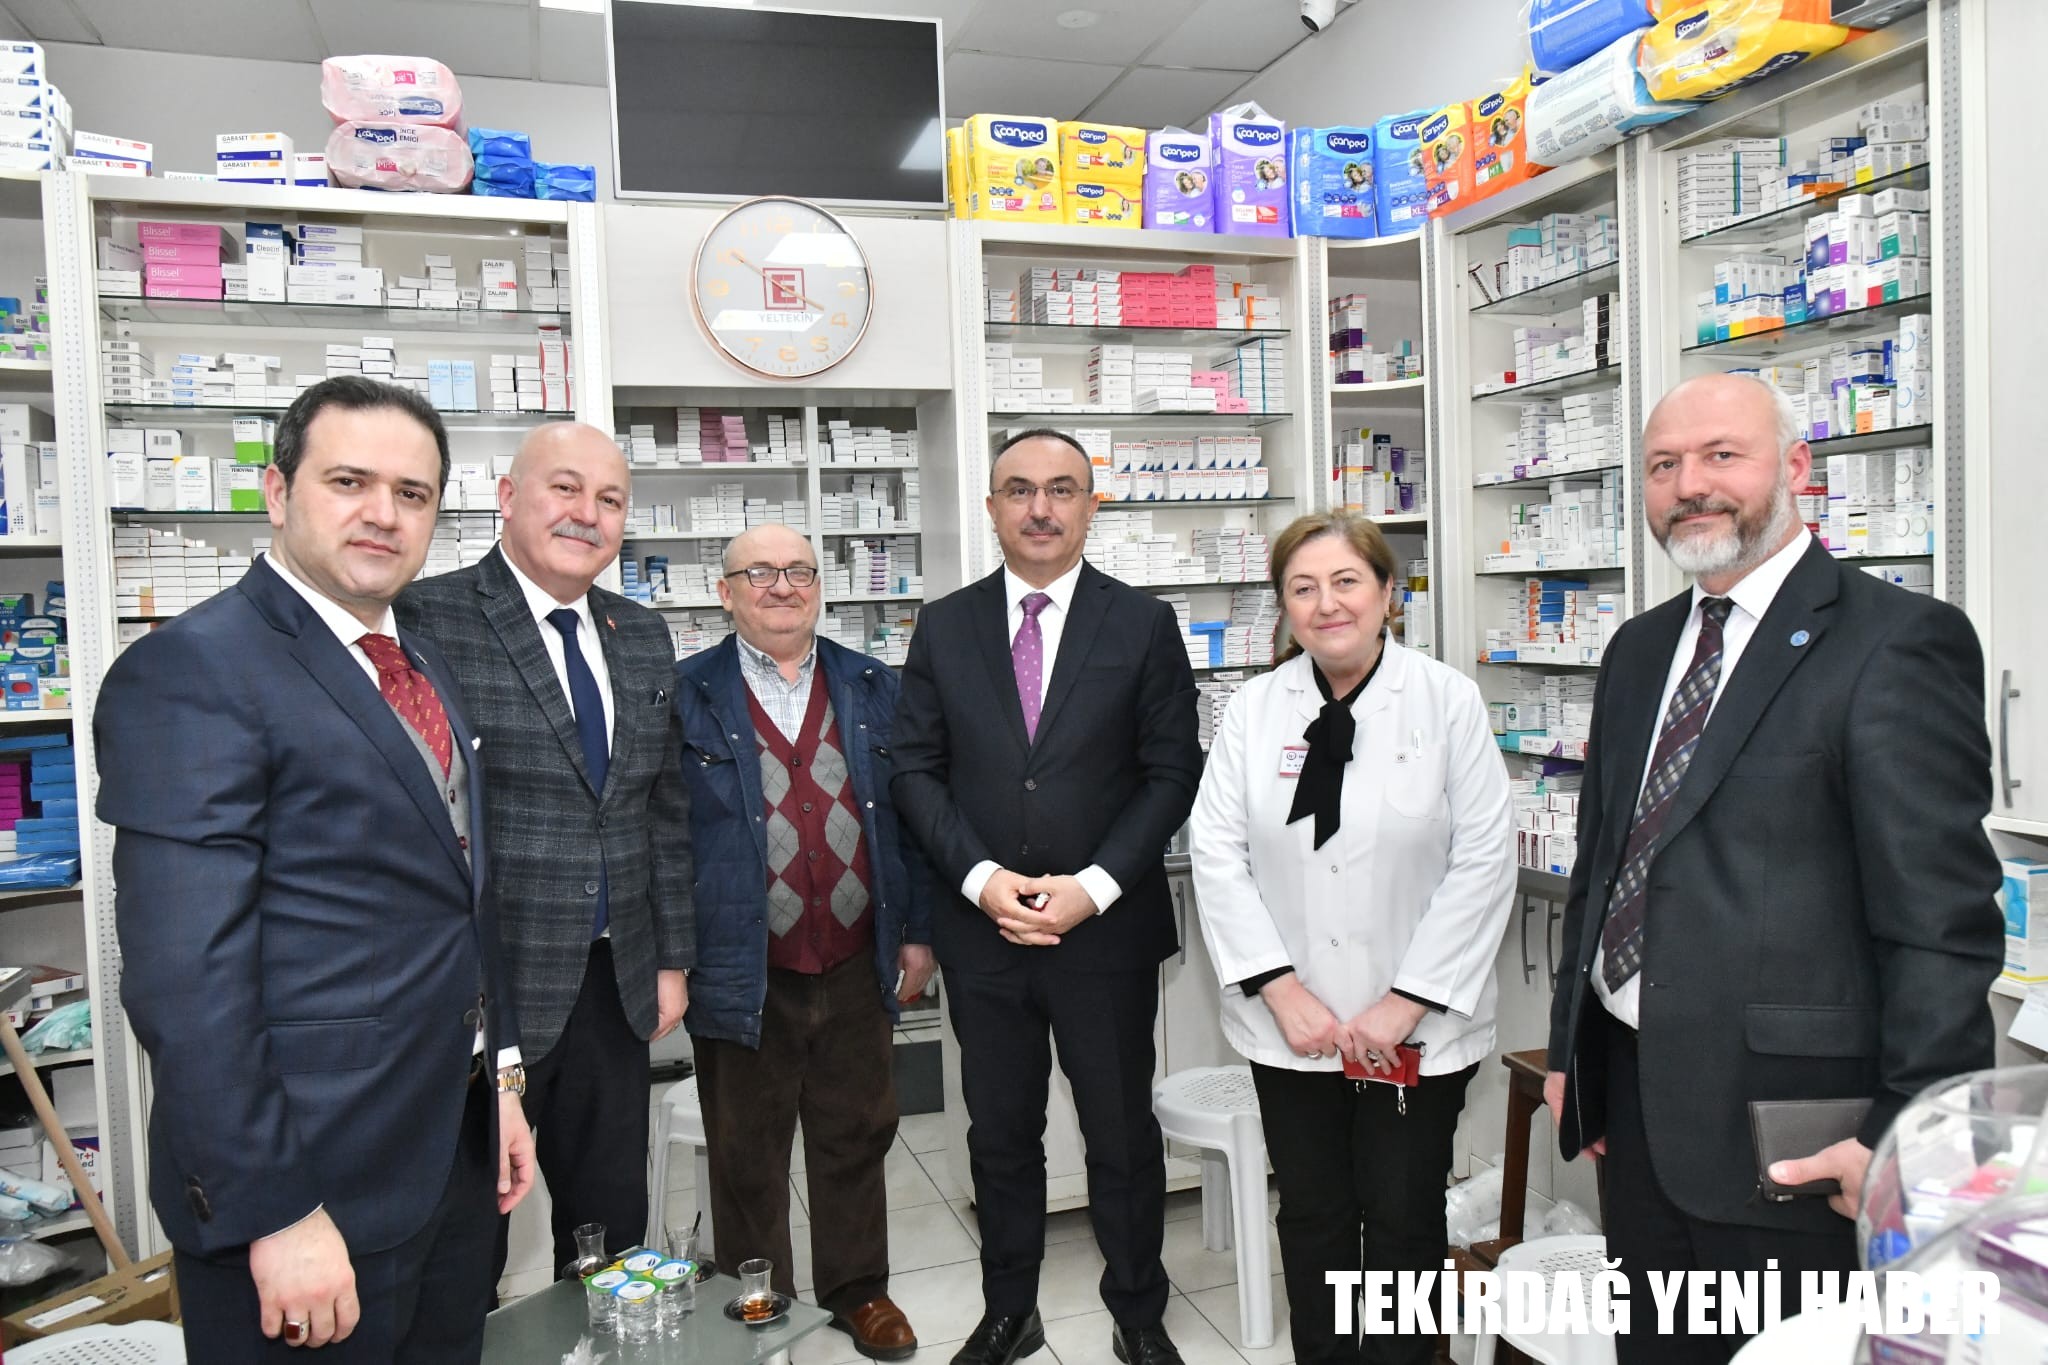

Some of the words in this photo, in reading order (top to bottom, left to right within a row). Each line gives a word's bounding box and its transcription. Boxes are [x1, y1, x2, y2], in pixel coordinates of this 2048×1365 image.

[357, 130, 396, 144] canped
[993, 124, 1045, 142] canped
[1080, 130, 1106, 142] canped
[1236, 127, 1280, 142] canped
[1328, 135, 1367, 150] canped
[1162, 146, 1199, 159] canped
[72, 158, 104, 167] GABASET
[1077, 185, 1104, 196] canped
[143, 226, 171, 236] Blissel
[148, 246, 177, 256] Blissel
[151, 267, 180, 277] Blissel
[150, 288, 179, 297] Blissel
[758, 311, 814, 323] YELTEKİN
